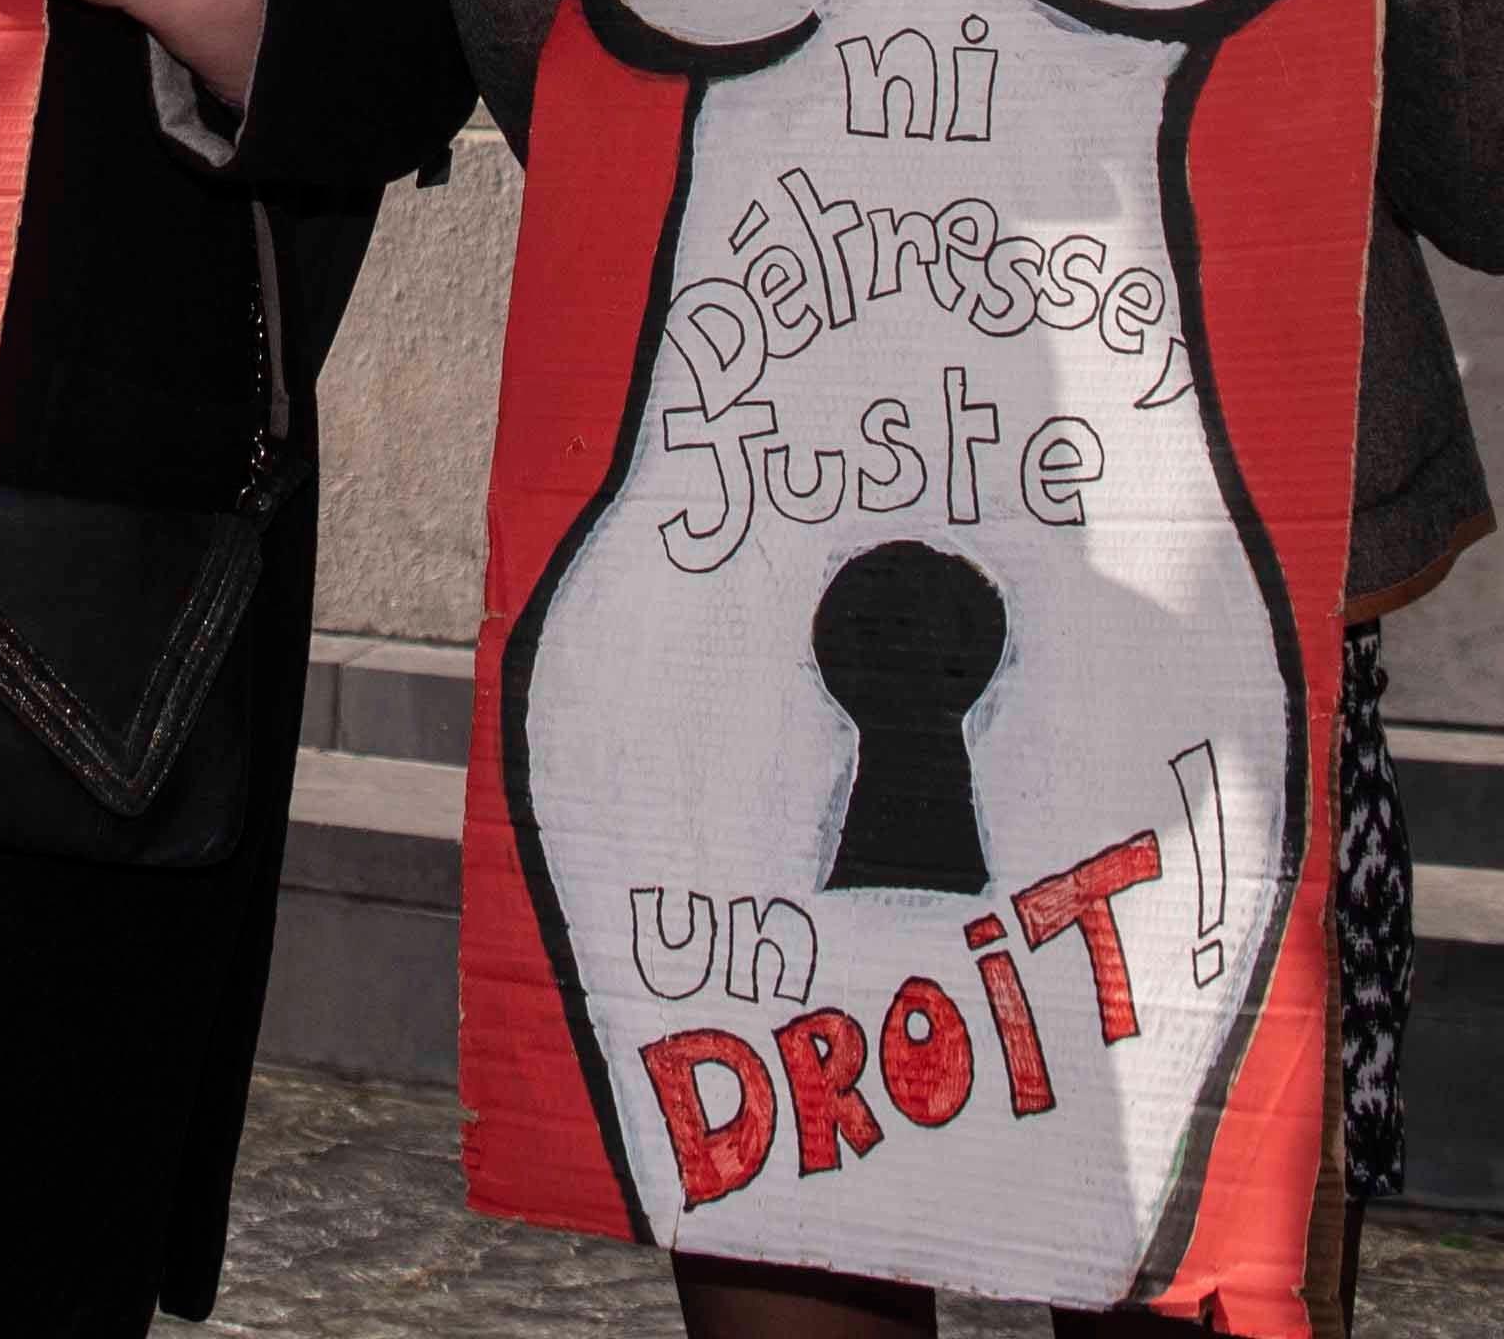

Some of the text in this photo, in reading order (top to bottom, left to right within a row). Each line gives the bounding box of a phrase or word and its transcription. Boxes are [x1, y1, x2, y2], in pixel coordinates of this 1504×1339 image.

[835, 13, 1001, 142] ni
[658, 366, 1105, 573] Juste
[630, 886, 820, 1005] un
